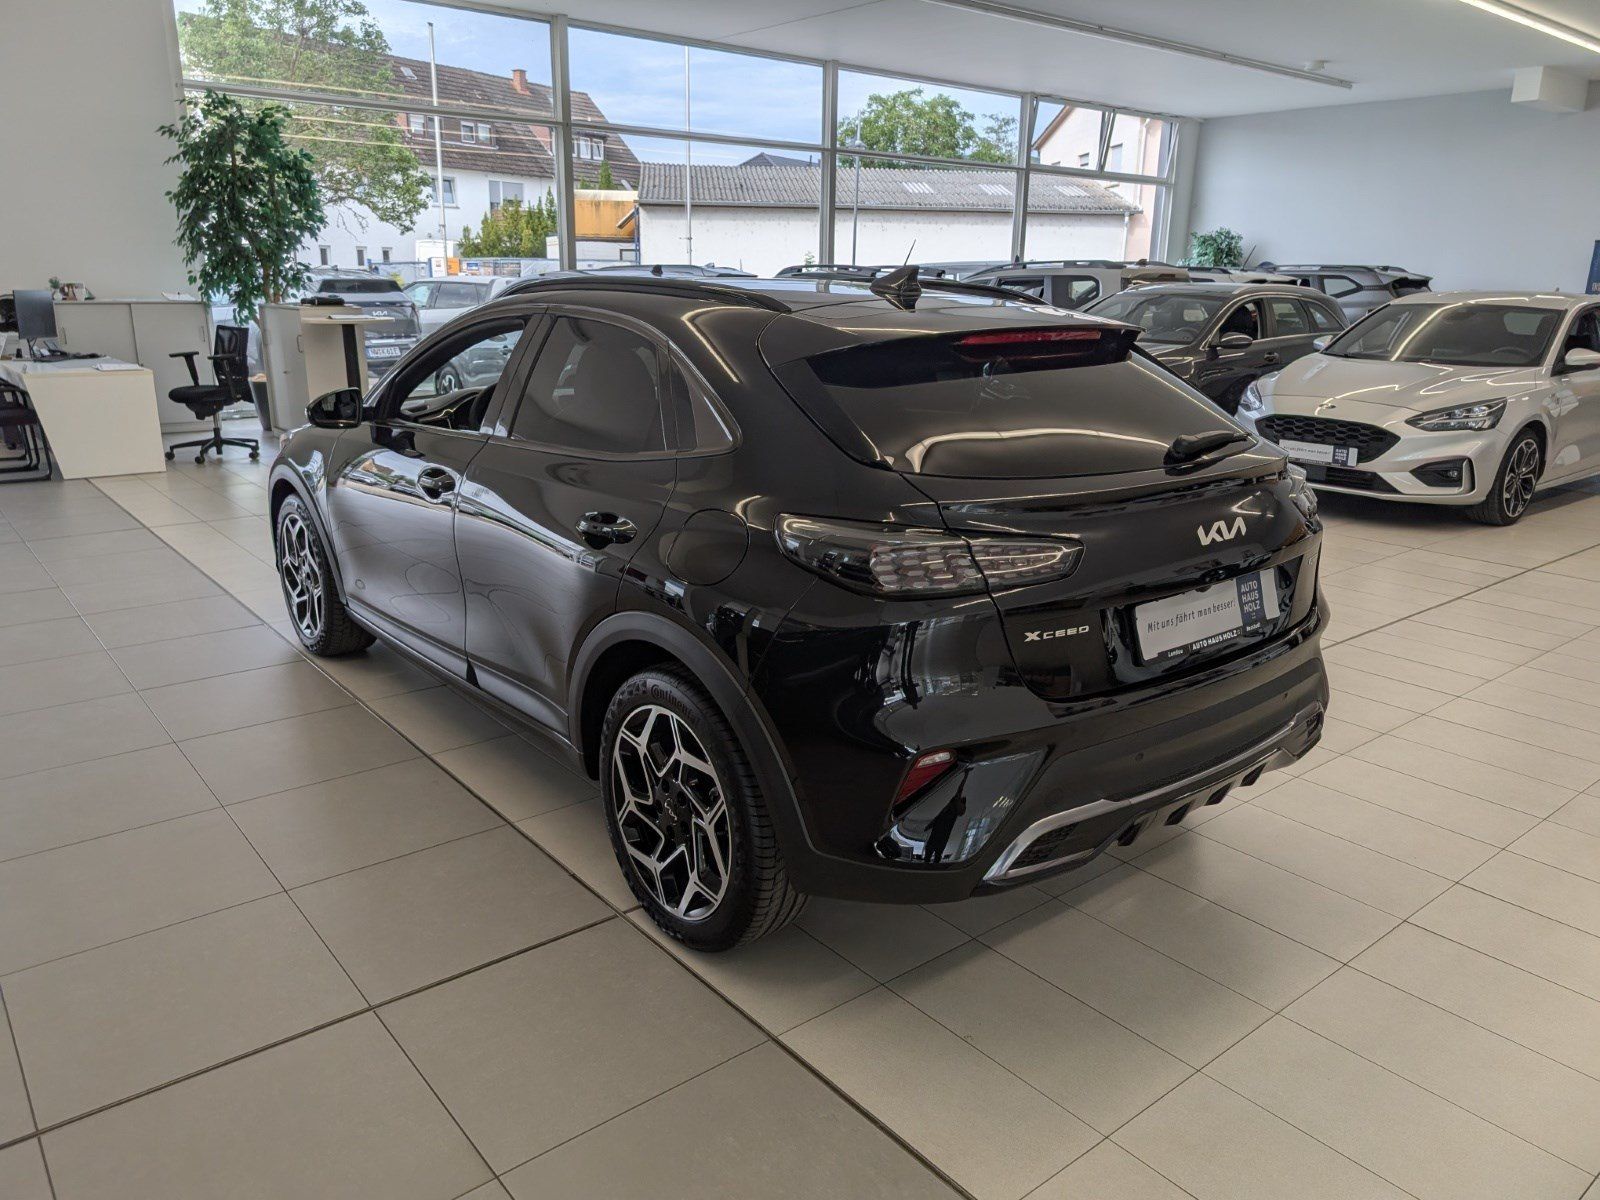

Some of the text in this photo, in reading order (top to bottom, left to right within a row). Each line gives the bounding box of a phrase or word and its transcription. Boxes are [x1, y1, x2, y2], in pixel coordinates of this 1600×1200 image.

[1197, 516, 1247, 546] KIA
[1240, 580, 1258, 593] AUTO
[1241, 590, 1259, 603] HAUS
[1243, 600, 1261, 614] HOLZ
[1147, 620, 1160, 633] Mit
[1161, 618, 1174, 629] uns
[1175, 610, 1195, 627] fährt
[1197, 606, 1212, 618] man
[1192, 639, 1208, 651] AUTO
[1207, 634, 1223, 647] HAUS
[1222, 629, 1238, 641] HOLZ
